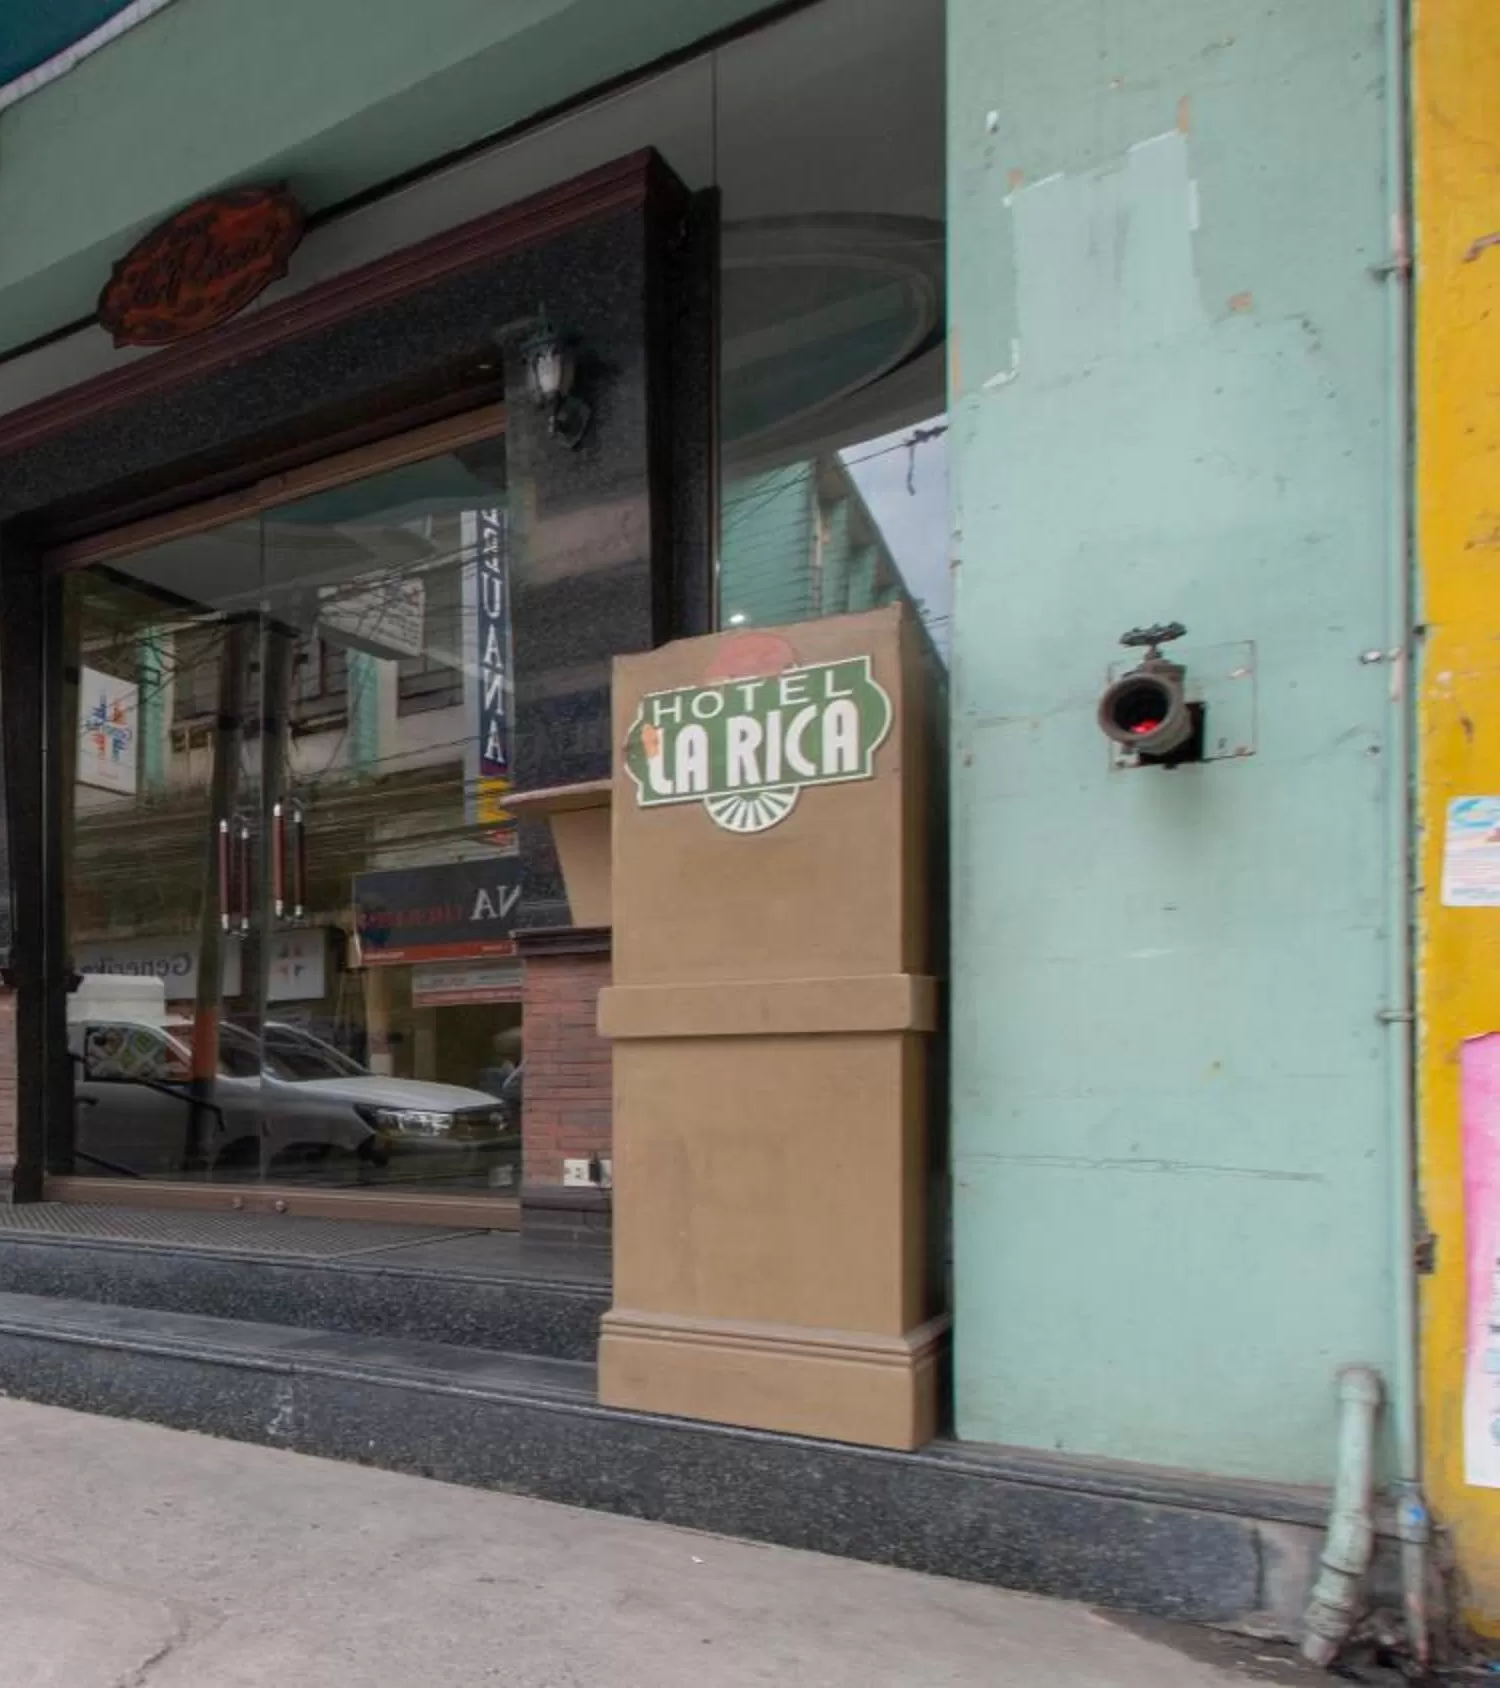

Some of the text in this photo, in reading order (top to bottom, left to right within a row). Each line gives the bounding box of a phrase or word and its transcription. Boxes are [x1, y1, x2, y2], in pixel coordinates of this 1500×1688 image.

[653, 669, 853, 726] HOTEL
[648, 699, 859, 795] LA RICA
